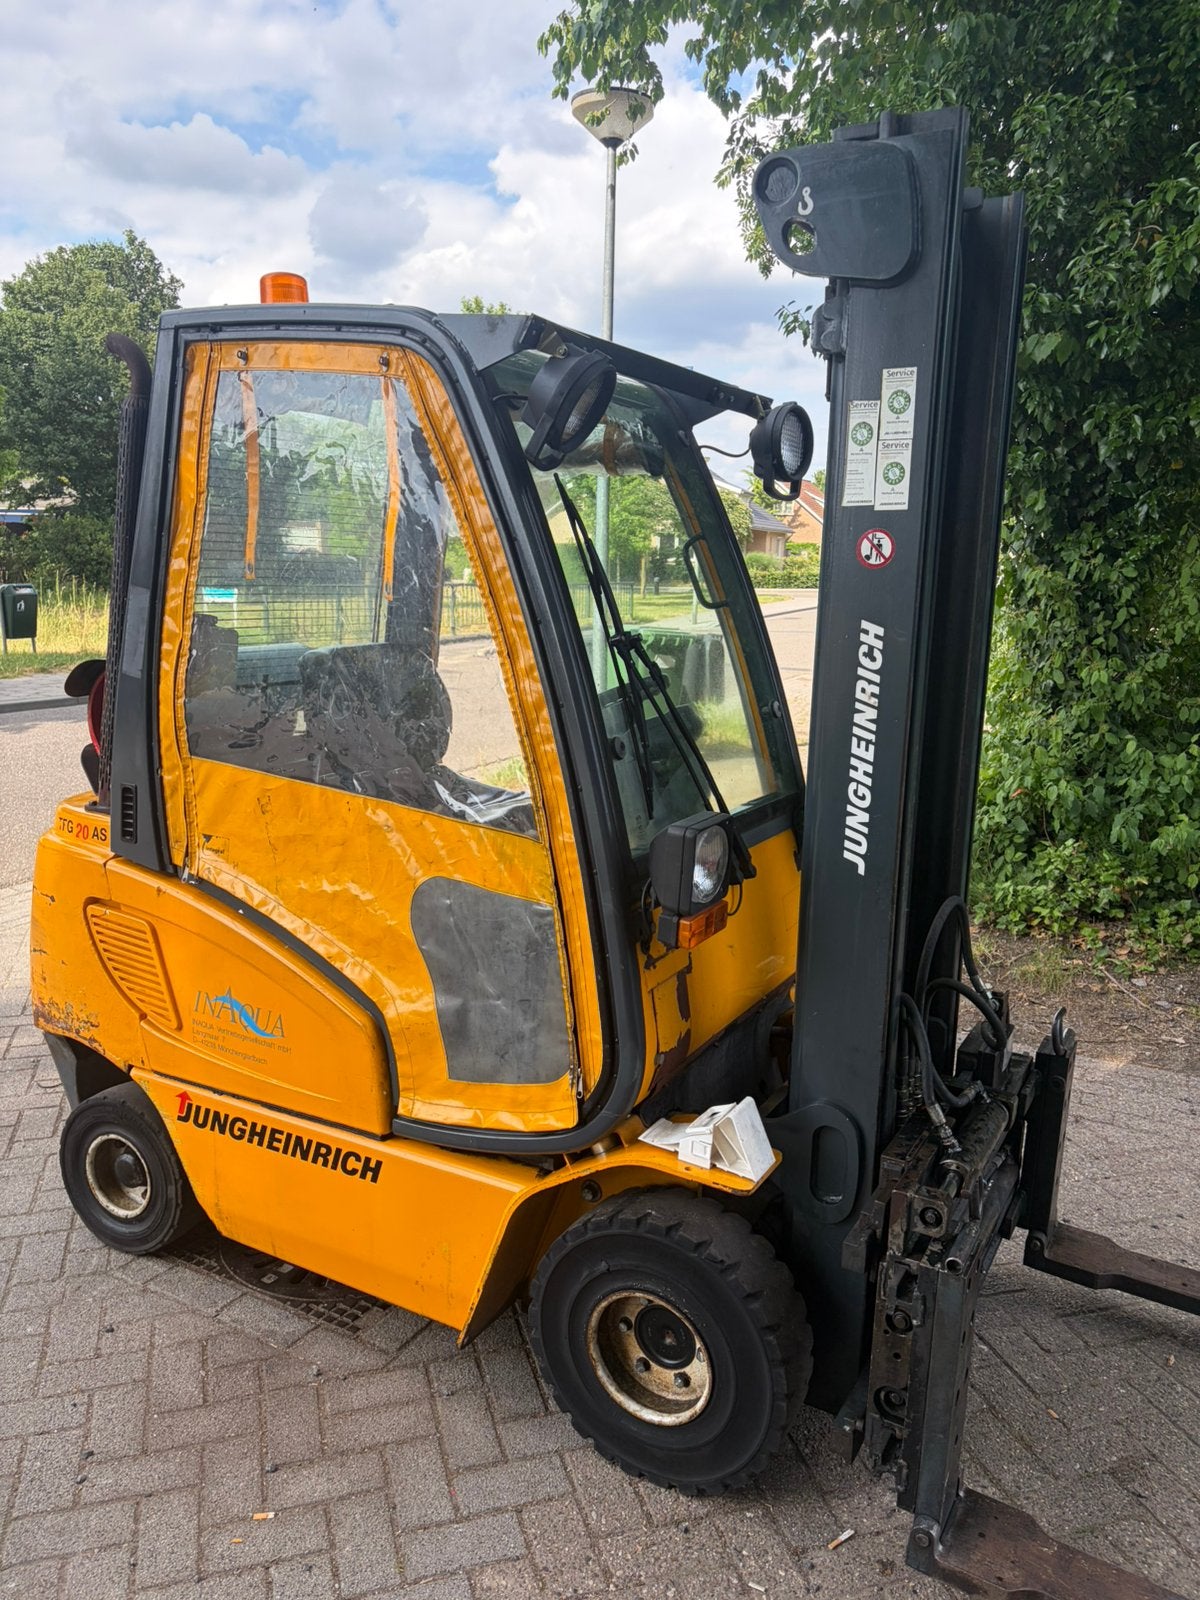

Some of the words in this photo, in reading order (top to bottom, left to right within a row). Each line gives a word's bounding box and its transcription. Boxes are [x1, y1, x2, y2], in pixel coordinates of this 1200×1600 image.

[886, 368, 915, 378] Service
[850, 401, 879, 409] Service
[881, 441, 910, 449] Service
[842, 619, 885, 877] JUNGHEINRICH
[75, 823, 89, 840] 20
[92, 826, 107, 842] AS
[194, 985, 285, 1038] INAQUA
[176, 1101, 383, 1184] JUNGHEINRICH
